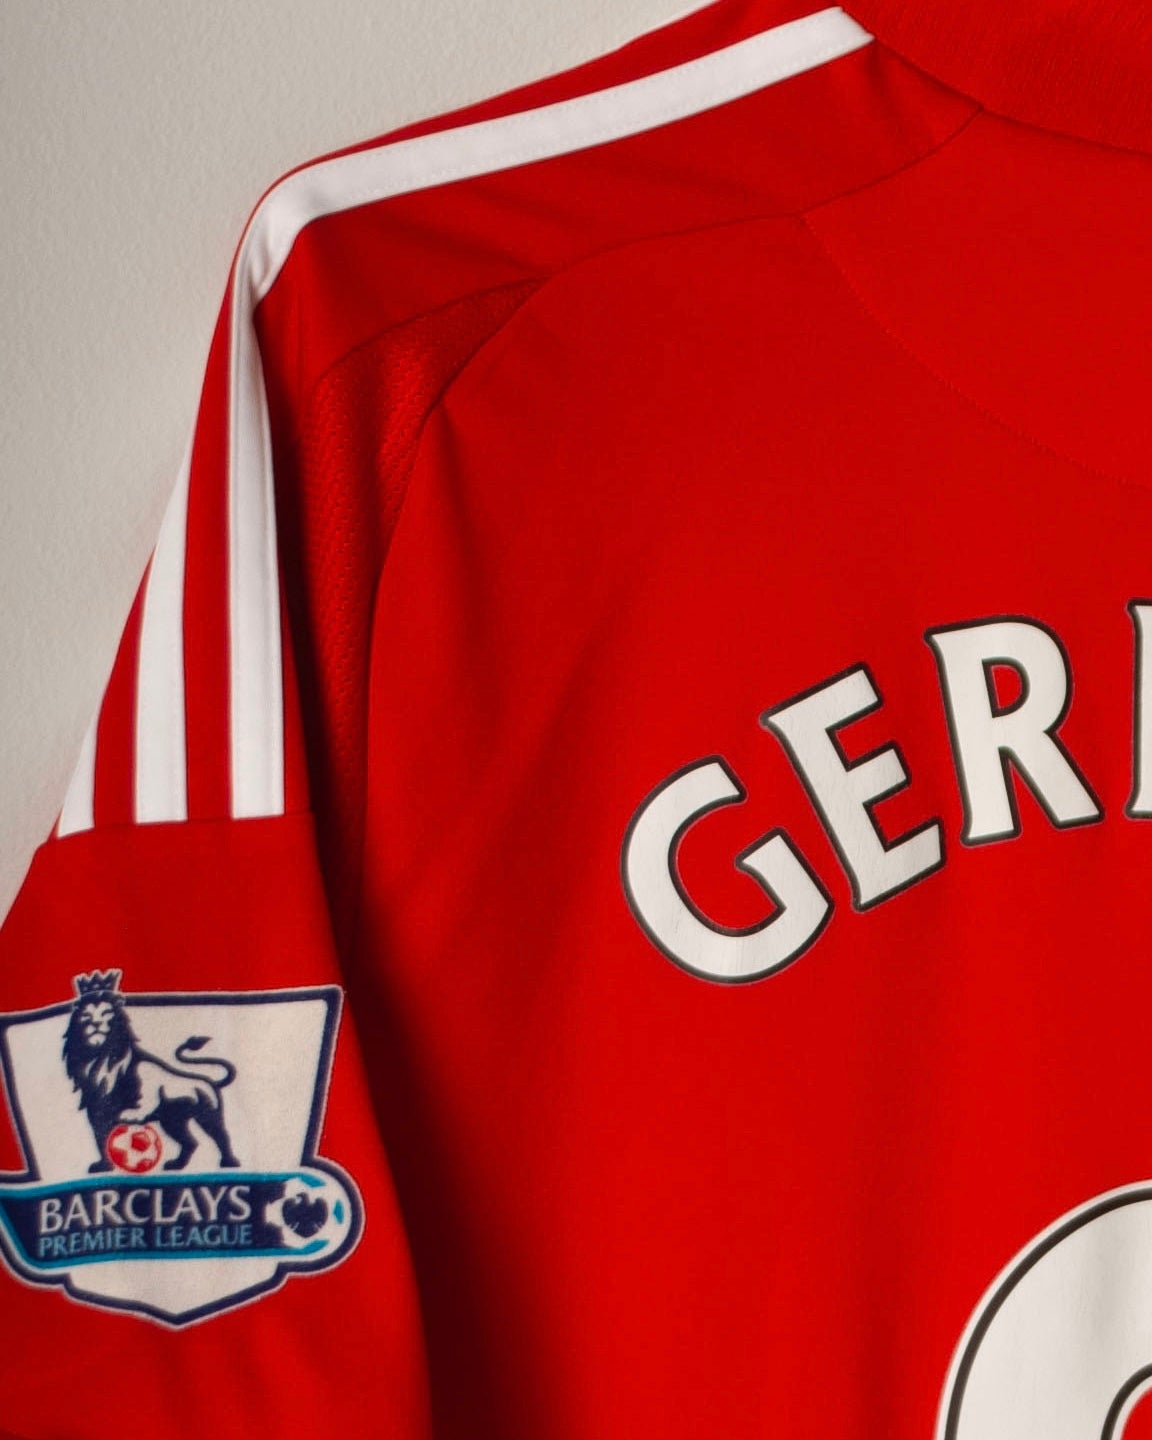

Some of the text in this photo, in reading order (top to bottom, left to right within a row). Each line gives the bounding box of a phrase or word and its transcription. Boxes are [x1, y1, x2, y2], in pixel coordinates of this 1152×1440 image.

[39, 1185, 252, 1235] BARCLAYS
[38, 1224, 253, 1257] PREMIER LEAGUE
